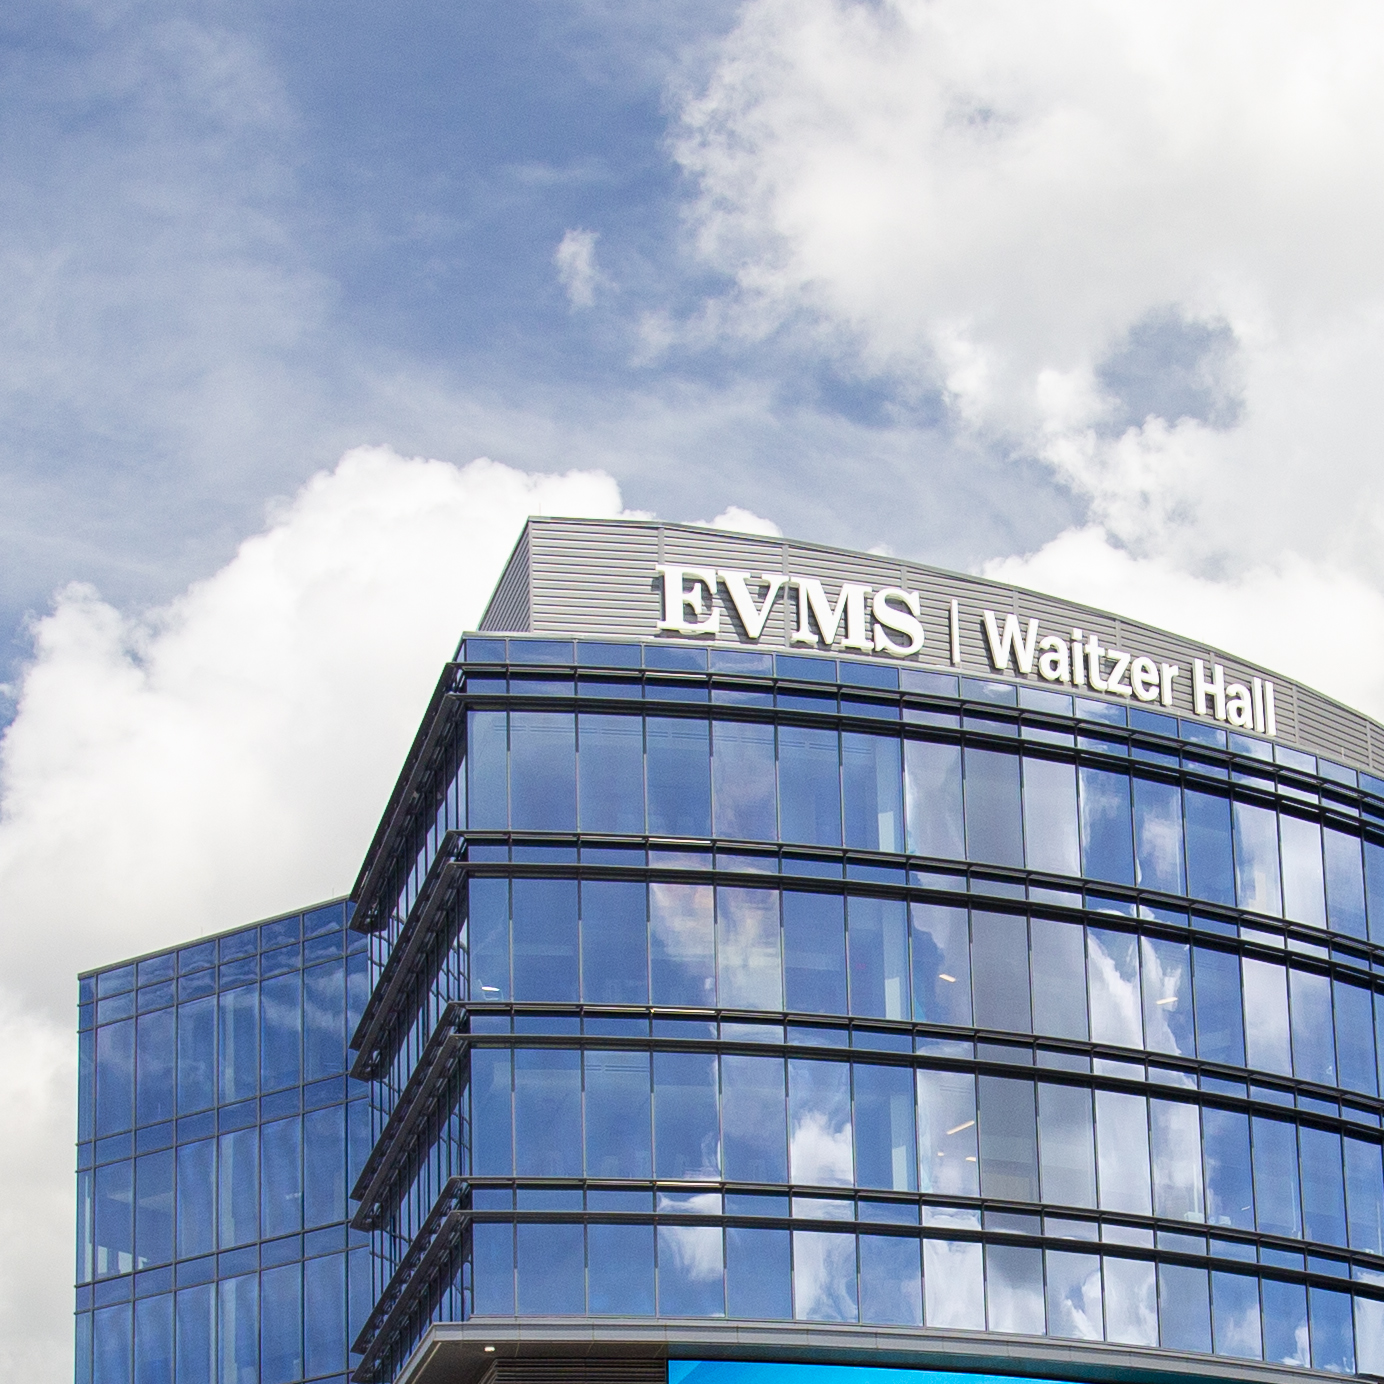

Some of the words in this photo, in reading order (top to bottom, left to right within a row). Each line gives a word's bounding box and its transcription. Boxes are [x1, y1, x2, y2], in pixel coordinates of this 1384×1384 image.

[656, 564, 924, 657] EVMS
[983, 610, 1180, 708] Waitzer
[1193, 656, 1278, 736] Hall
